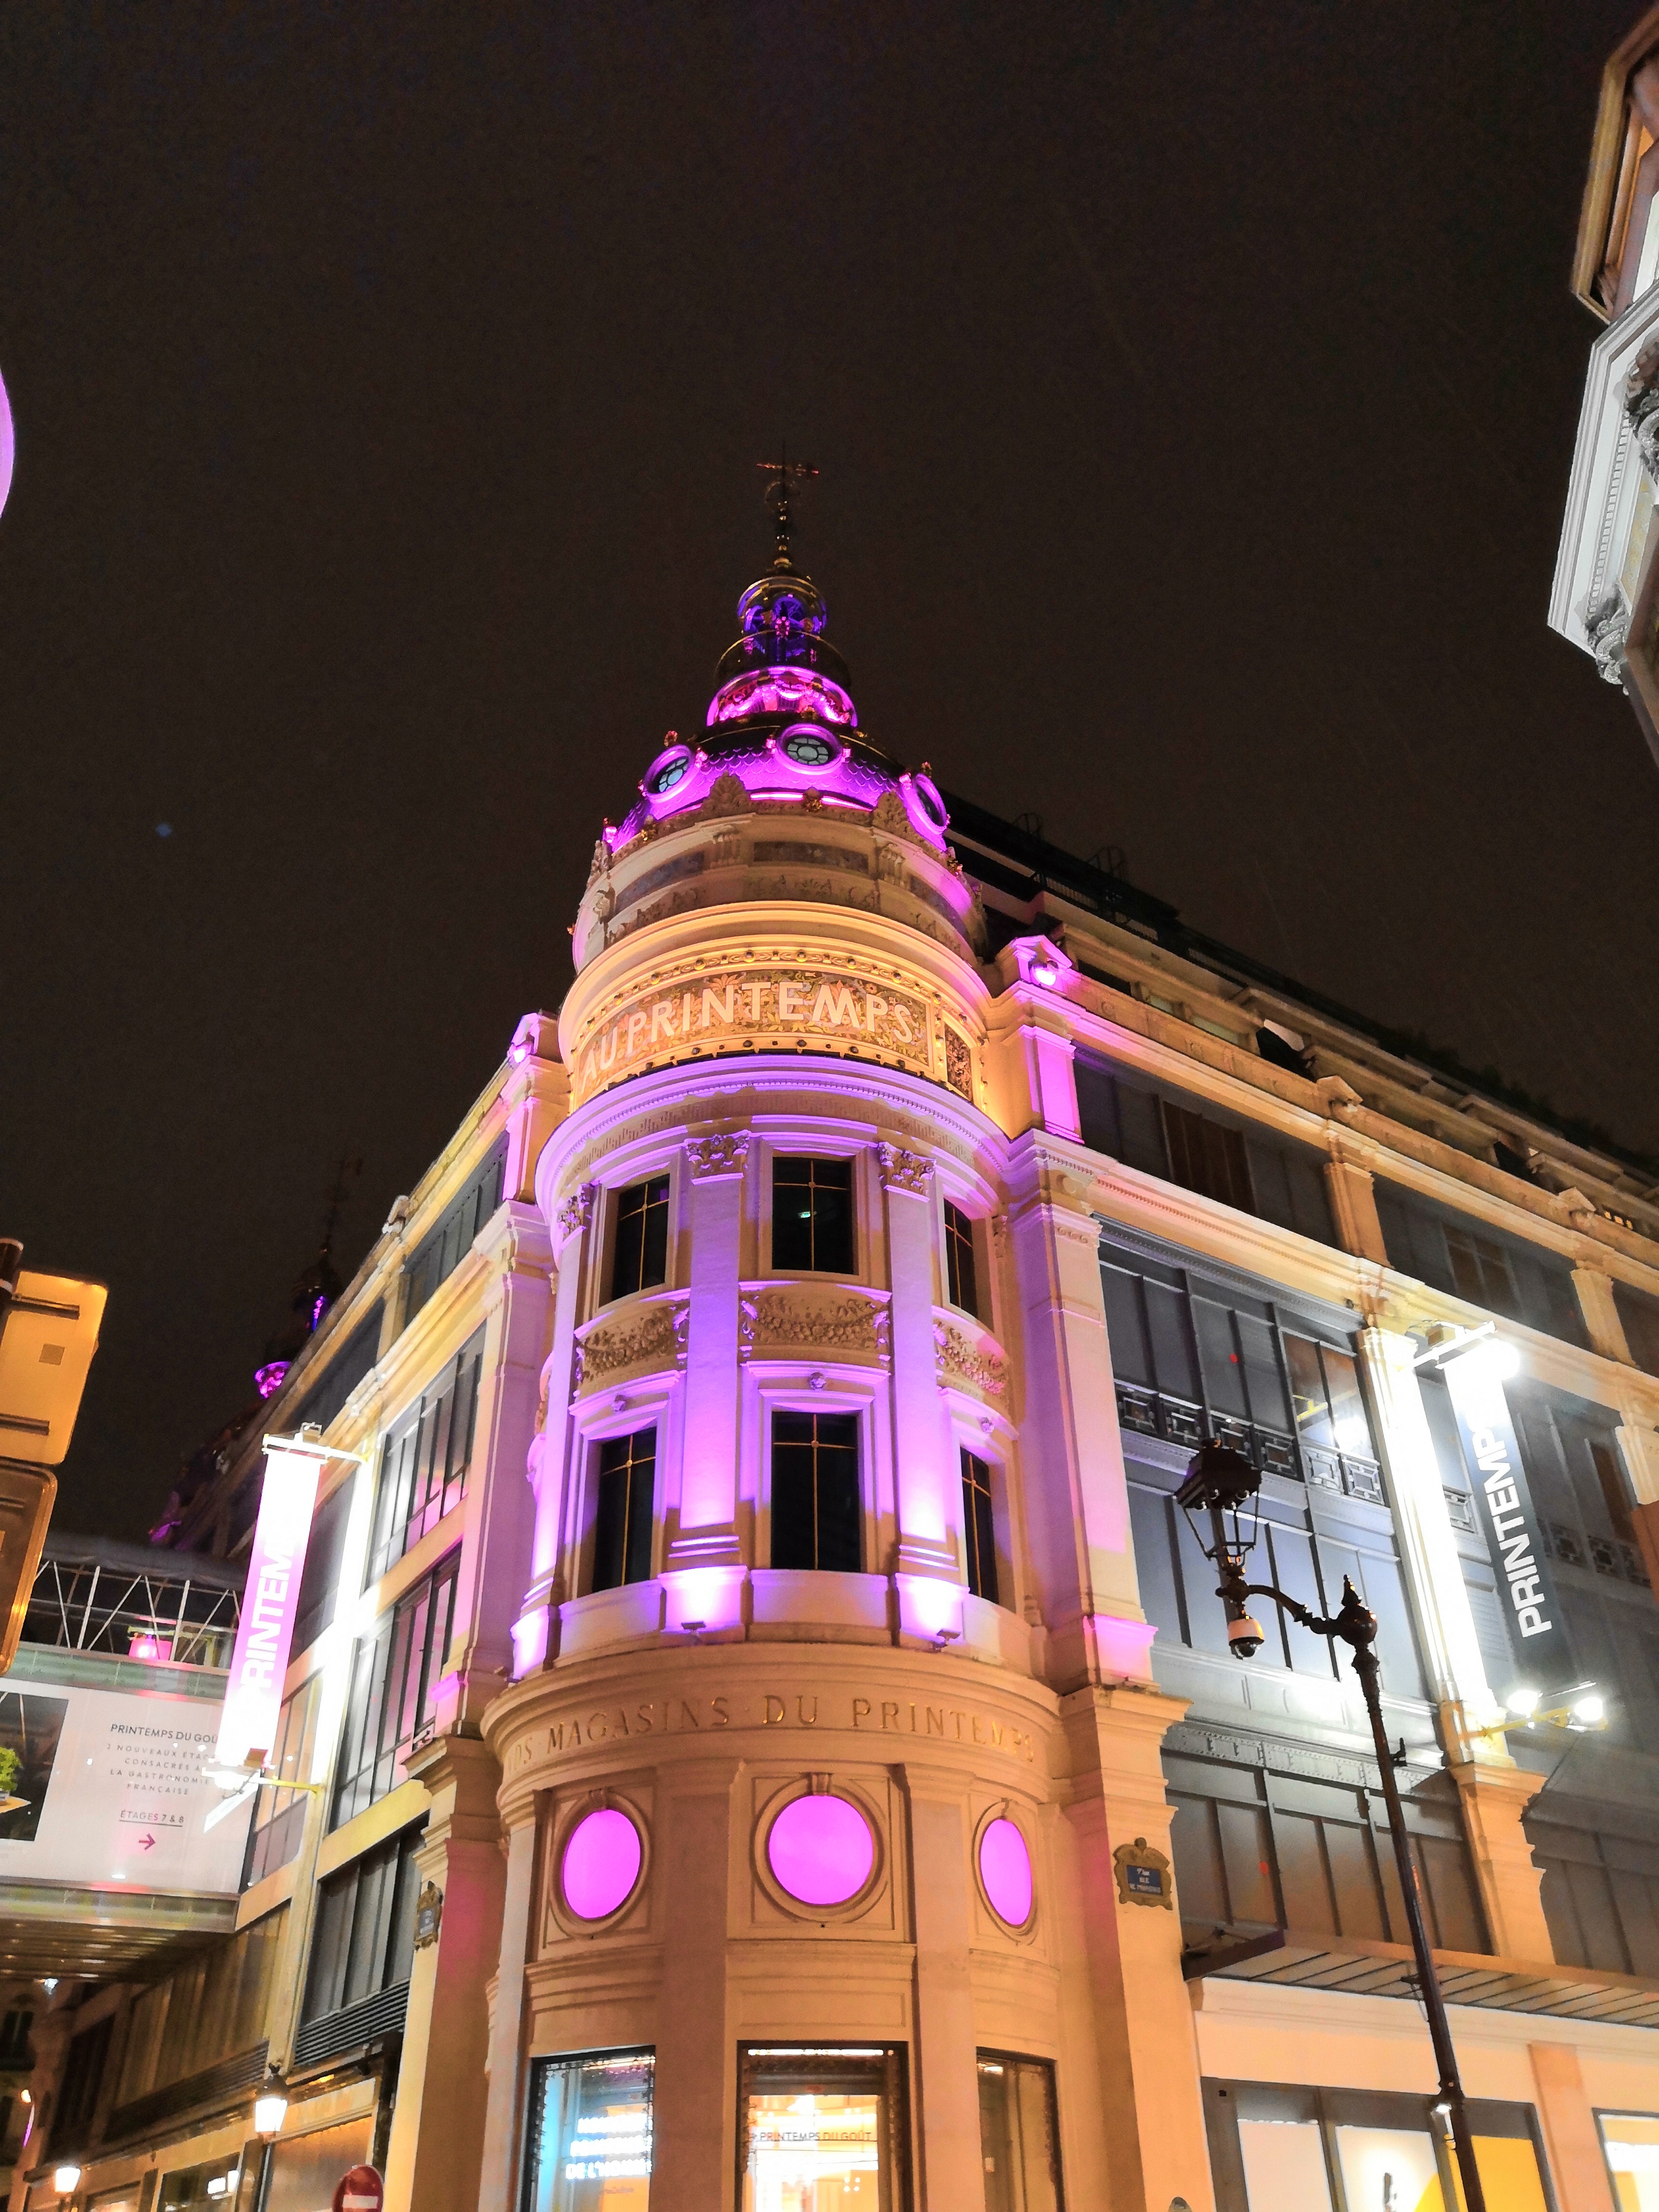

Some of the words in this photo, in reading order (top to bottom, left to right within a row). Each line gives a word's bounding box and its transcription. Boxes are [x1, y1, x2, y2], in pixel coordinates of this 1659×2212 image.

[580, 1023, 619, 1094] AU
[625, 981, 914, 1055] PRINTEMPS
[110, 1723, 173, 1739] PRINTEMPS
[176, 1731, 192, 1741] DU
[547, 1696, 729, 1754] MAGASINS
[763, 1695, 817, 1725] DU
[851, 1698, 1034, 1762] PRINTEMPS
[116, 1744, 177, 1757] NOUVEAUX
[127, 1783, 189, 1795] FRANÇAISE
[120, 1809, 158, 1821] ÉTAGES
